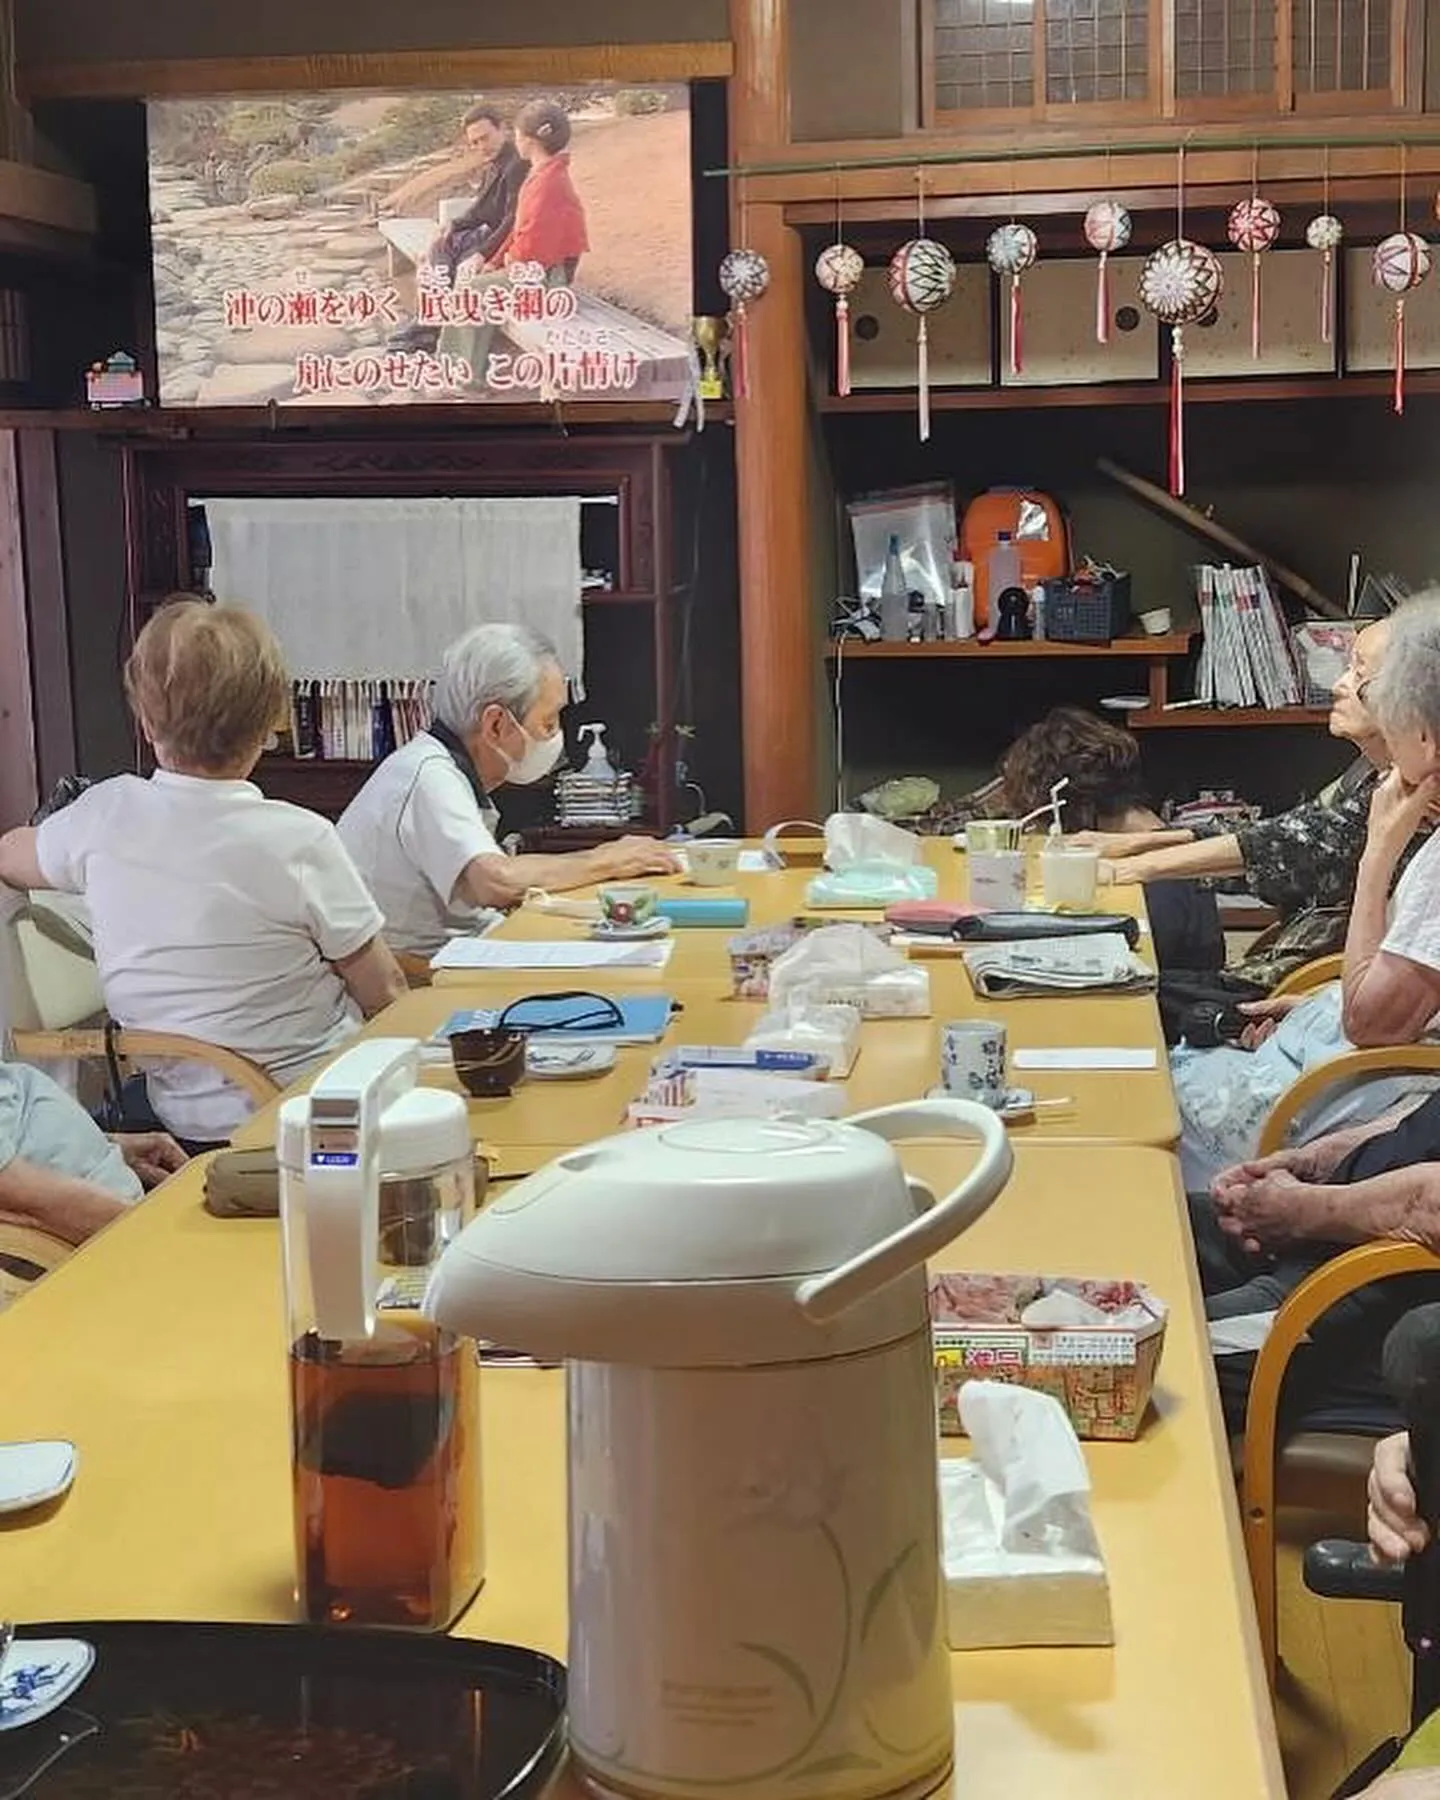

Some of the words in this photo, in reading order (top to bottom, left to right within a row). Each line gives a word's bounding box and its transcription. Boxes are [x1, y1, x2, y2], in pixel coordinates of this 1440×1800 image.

[225, 290, 400, 327] 沖の瀬をゆく
[418, 286, 576, 325] 底曳き網の
[294, 353, 471, 392] 舟にのせたい
[487, 352, 640, 391] この片情け
